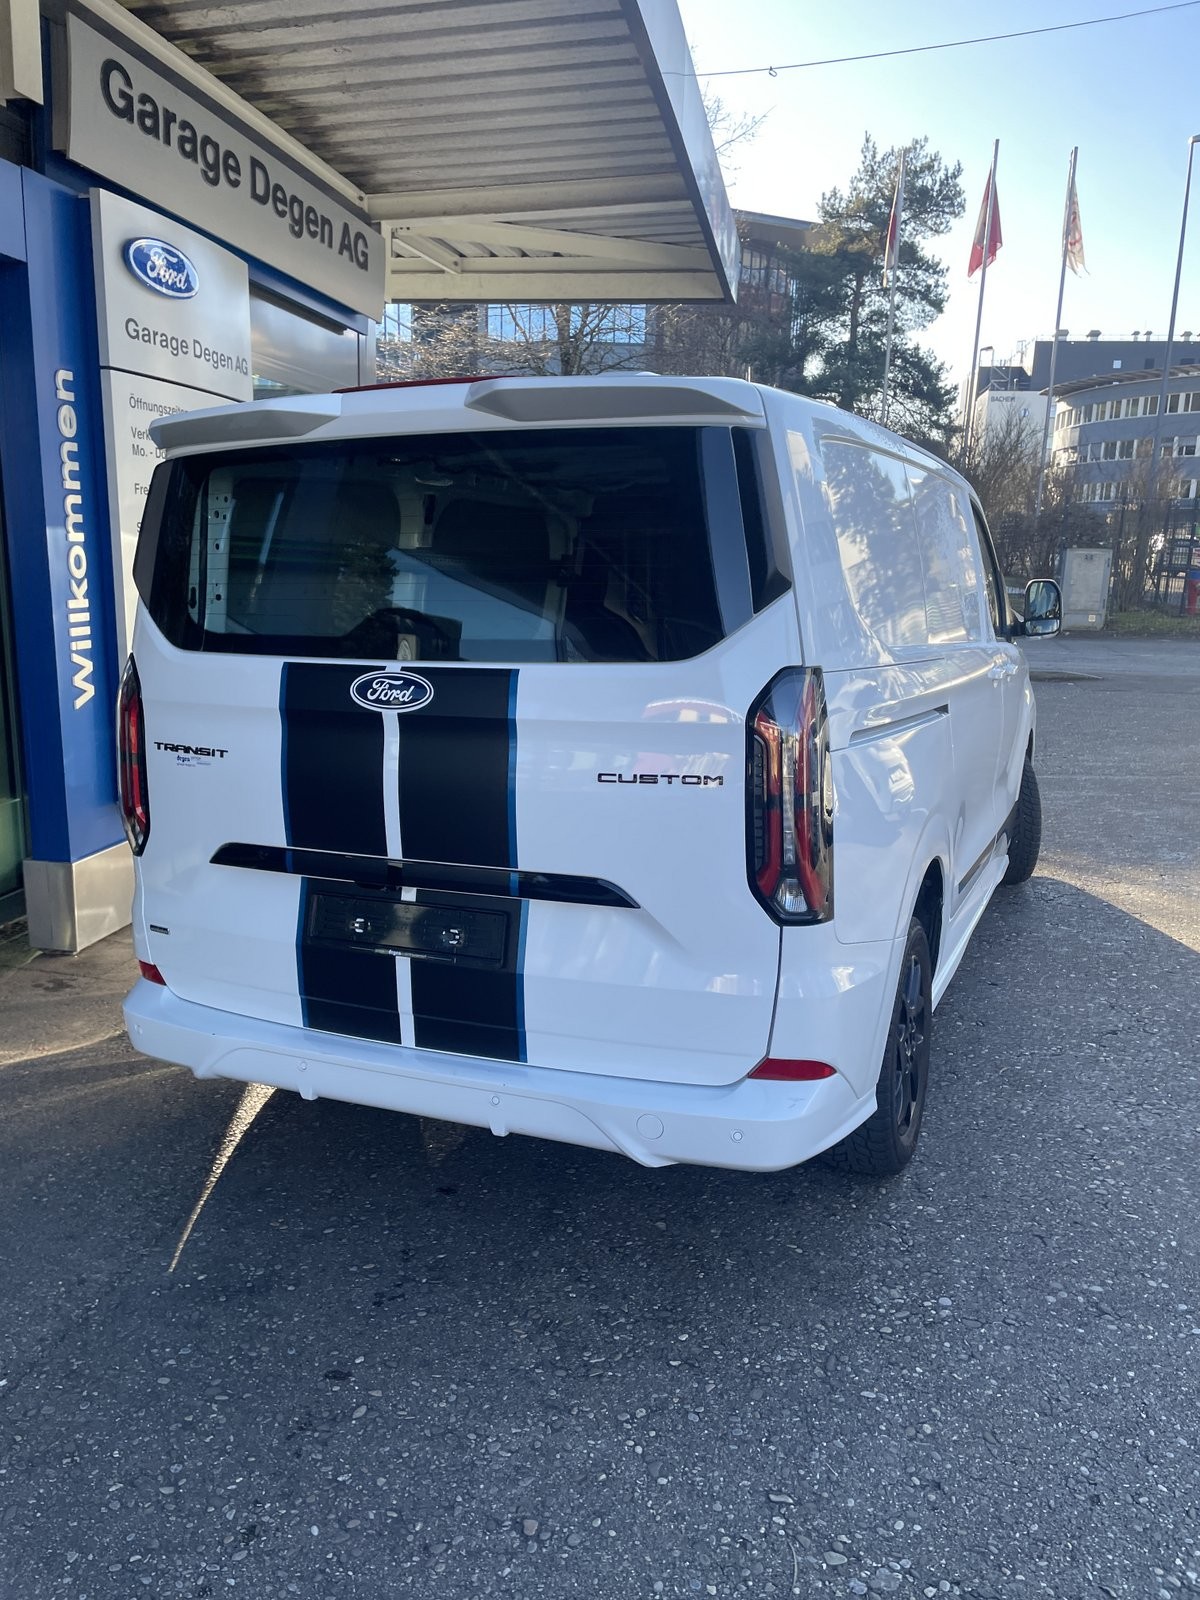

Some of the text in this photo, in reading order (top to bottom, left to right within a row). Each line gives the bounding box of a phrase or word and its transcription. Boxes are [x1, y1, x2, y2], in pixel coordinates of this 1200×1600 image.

[101, 59, 369, 271] Garage Degen AG
[146, 247, 188, 290] Ford
[125, 317, 249, 376] Garage Degen AG
[129, 393, 189, 416] Öffnungszei
[132, 444, 148, 457] Mo.
[54, 368, 96, 710] Willkommen
[367, 678, 415, 702] Ford
[154, 741, 229, 758] TRANSIT
[597, 773, 724, 786] CUSTOM
